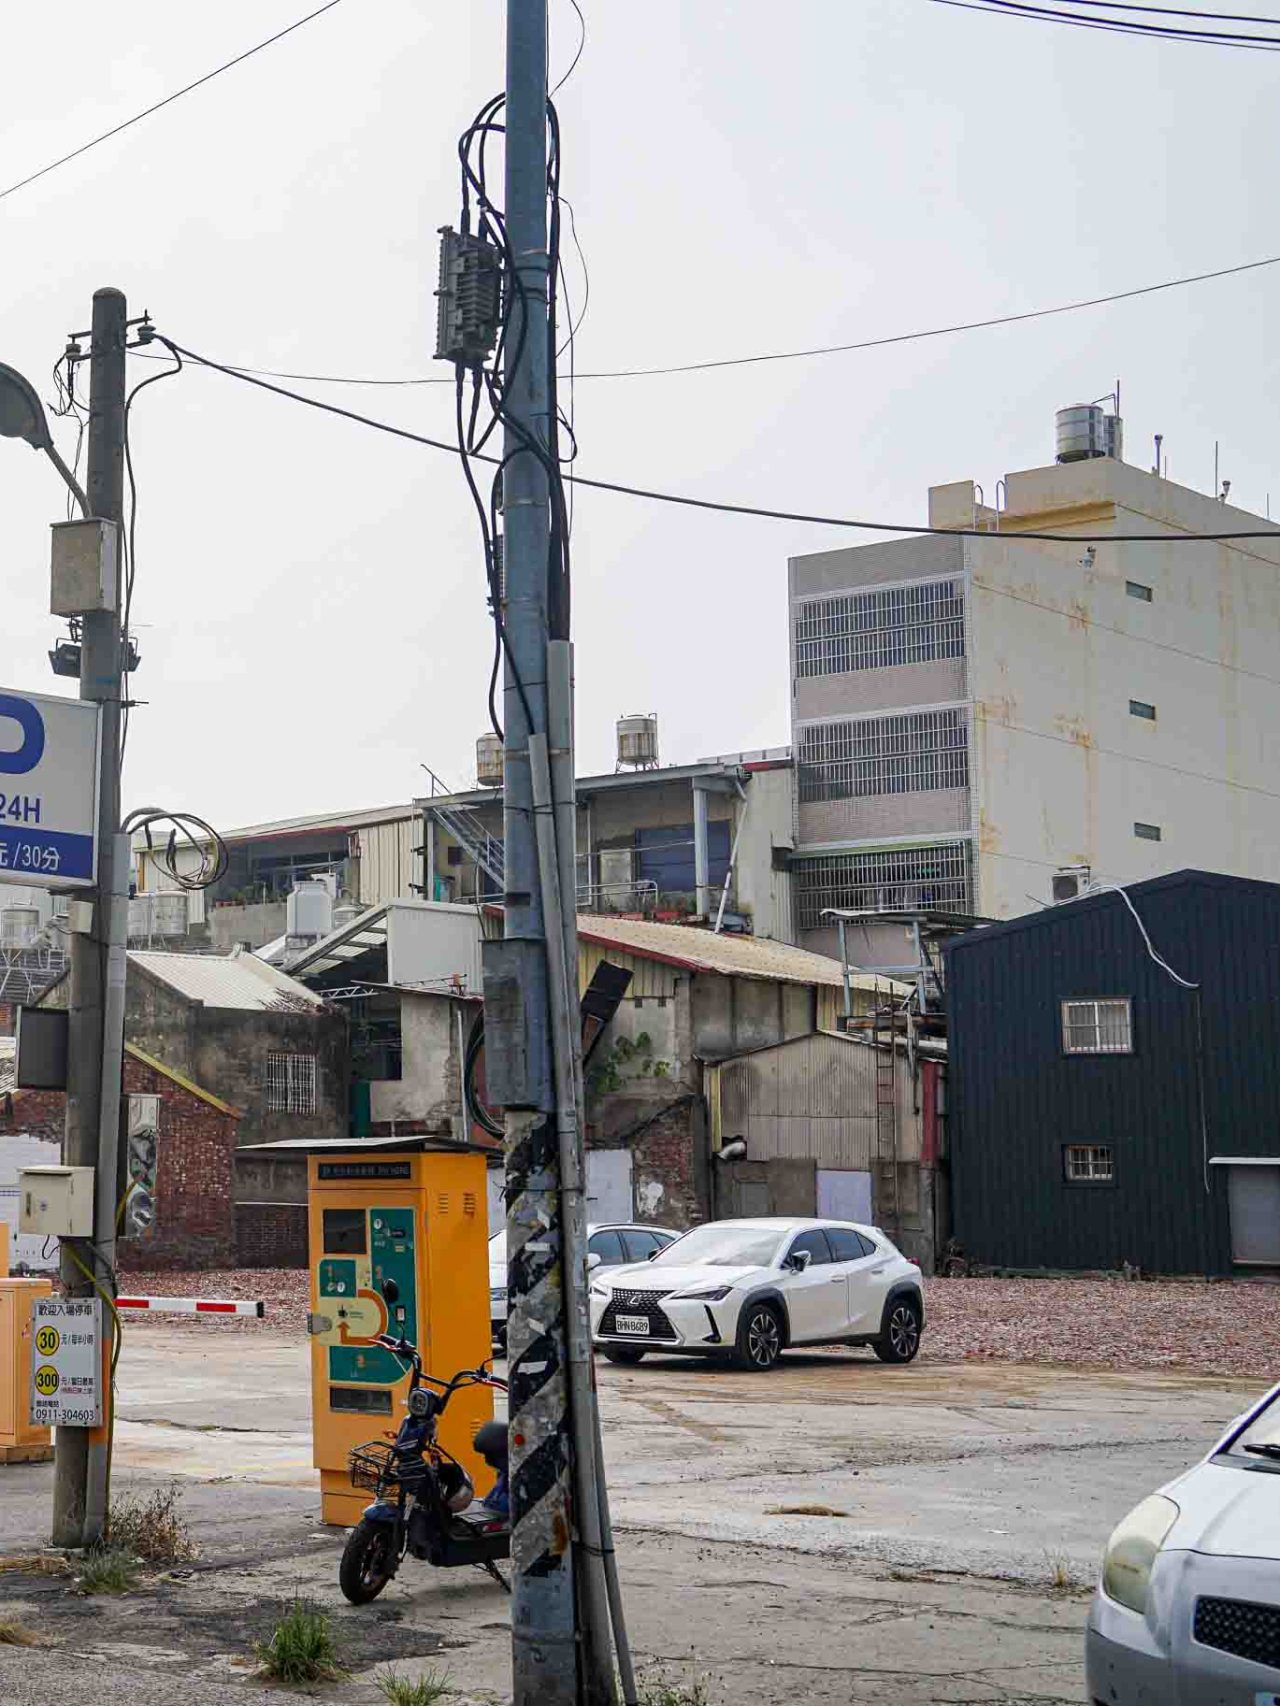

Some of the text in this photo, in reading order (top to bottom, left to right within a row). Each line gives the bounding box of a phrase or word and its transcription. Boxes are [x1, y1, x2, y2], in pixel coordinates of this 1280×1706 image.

[40, 1332, 56, 1349] 30
[37, 1373, 58, 1388] 300
[35, 1409, 95, 1421] 0911-304603
